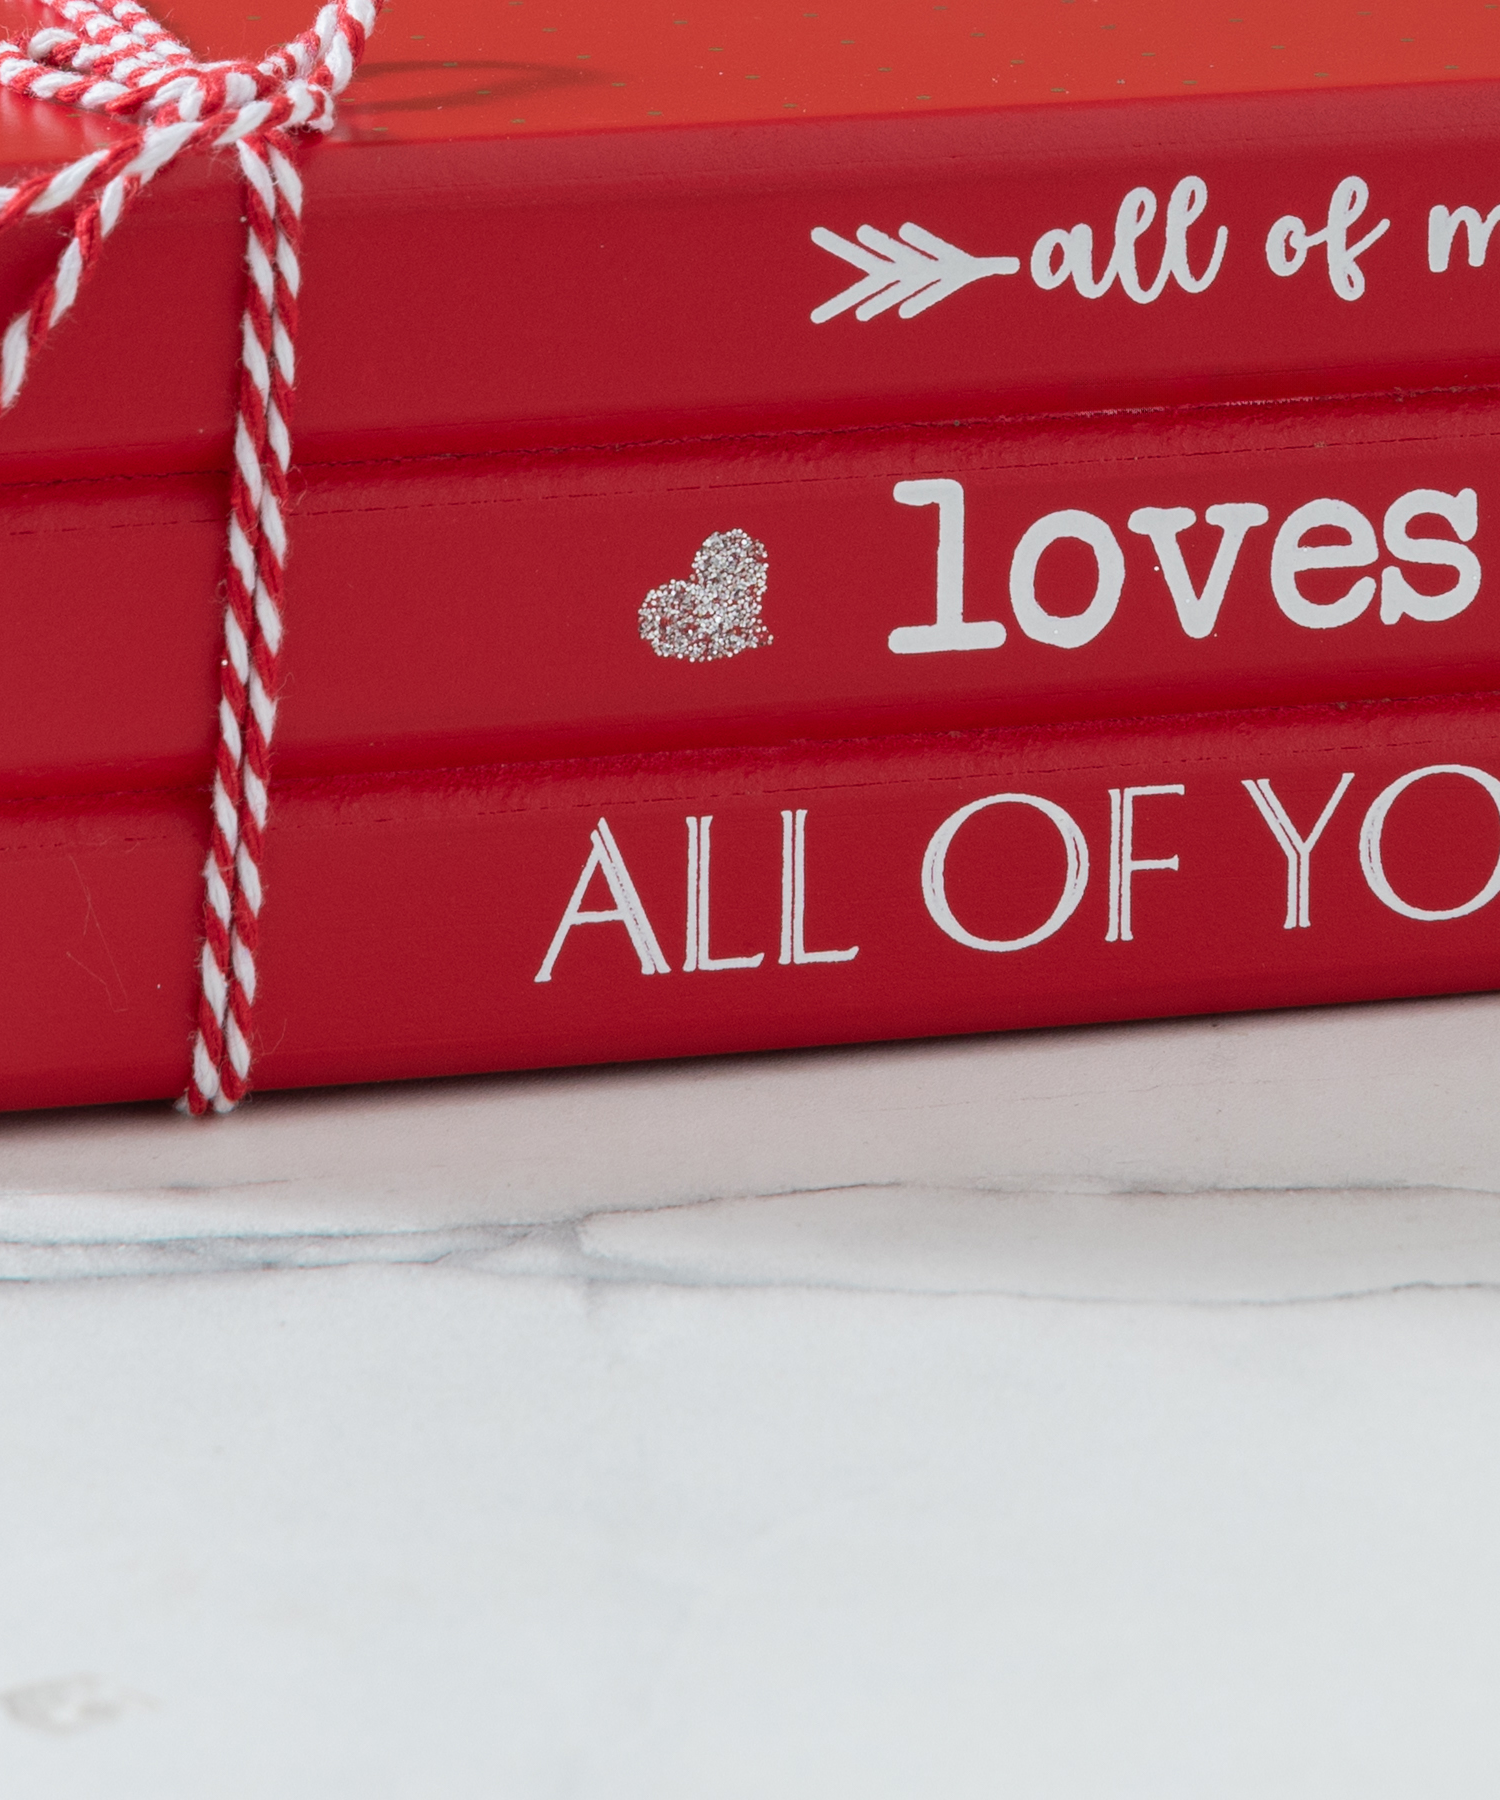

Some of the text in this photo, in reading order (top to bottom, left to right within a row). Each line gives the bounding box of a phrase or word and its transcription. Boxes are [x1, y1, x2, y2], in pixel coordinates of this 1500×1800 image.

[1031, 176, 1228, 304] all
[1265, 176, 1390, 301] of
[888, 478, 1481, 654] loves
[534, 809, 859, 982] ALL
[921, 784, 1184, 952] OF
